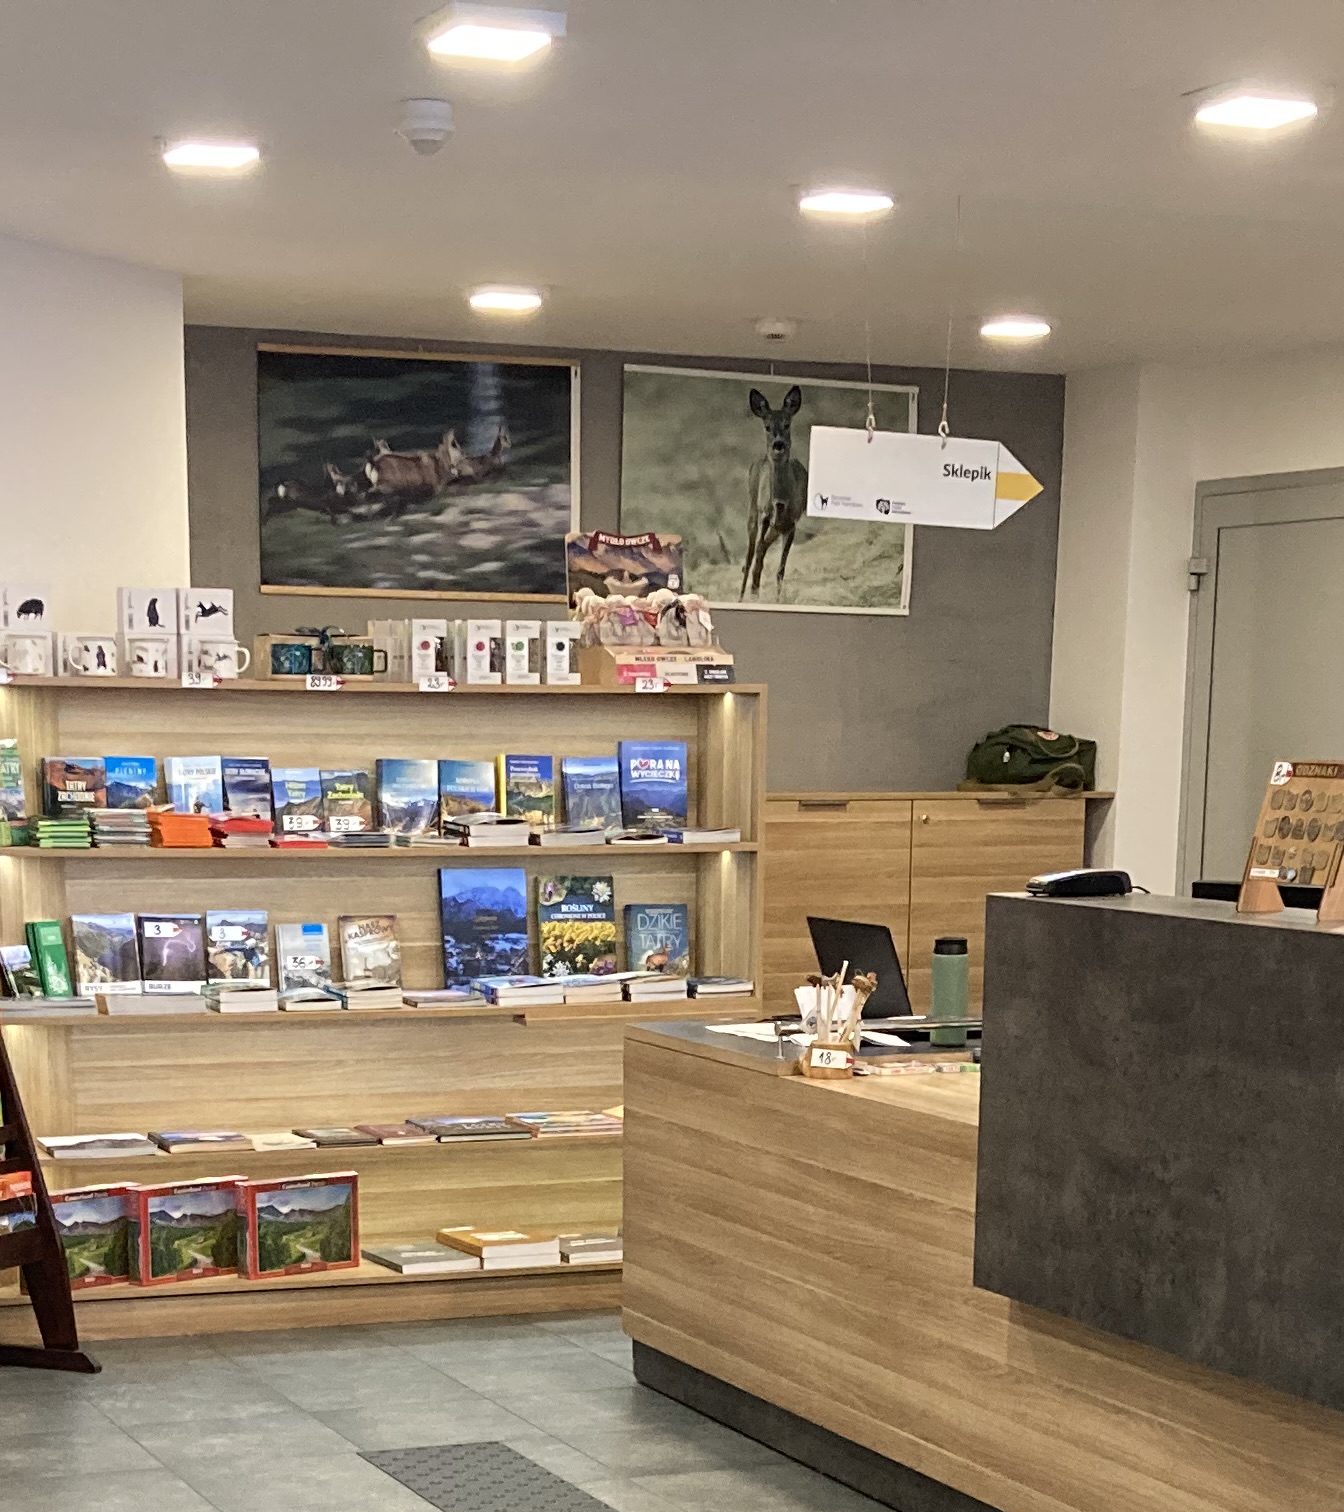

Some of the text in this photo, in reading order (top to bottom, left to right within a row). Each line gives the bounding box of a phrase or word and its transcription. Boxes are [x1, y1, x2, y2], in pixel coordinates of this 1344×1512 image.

[942, 463, 992, 482] Sklepik
[665, 759, 681, 770] NA
[560, 903, 594, 912] ROŚLINY
[637, 913, 683, 931] DZIKIE
[638, 933, 682, 950] TATRY
